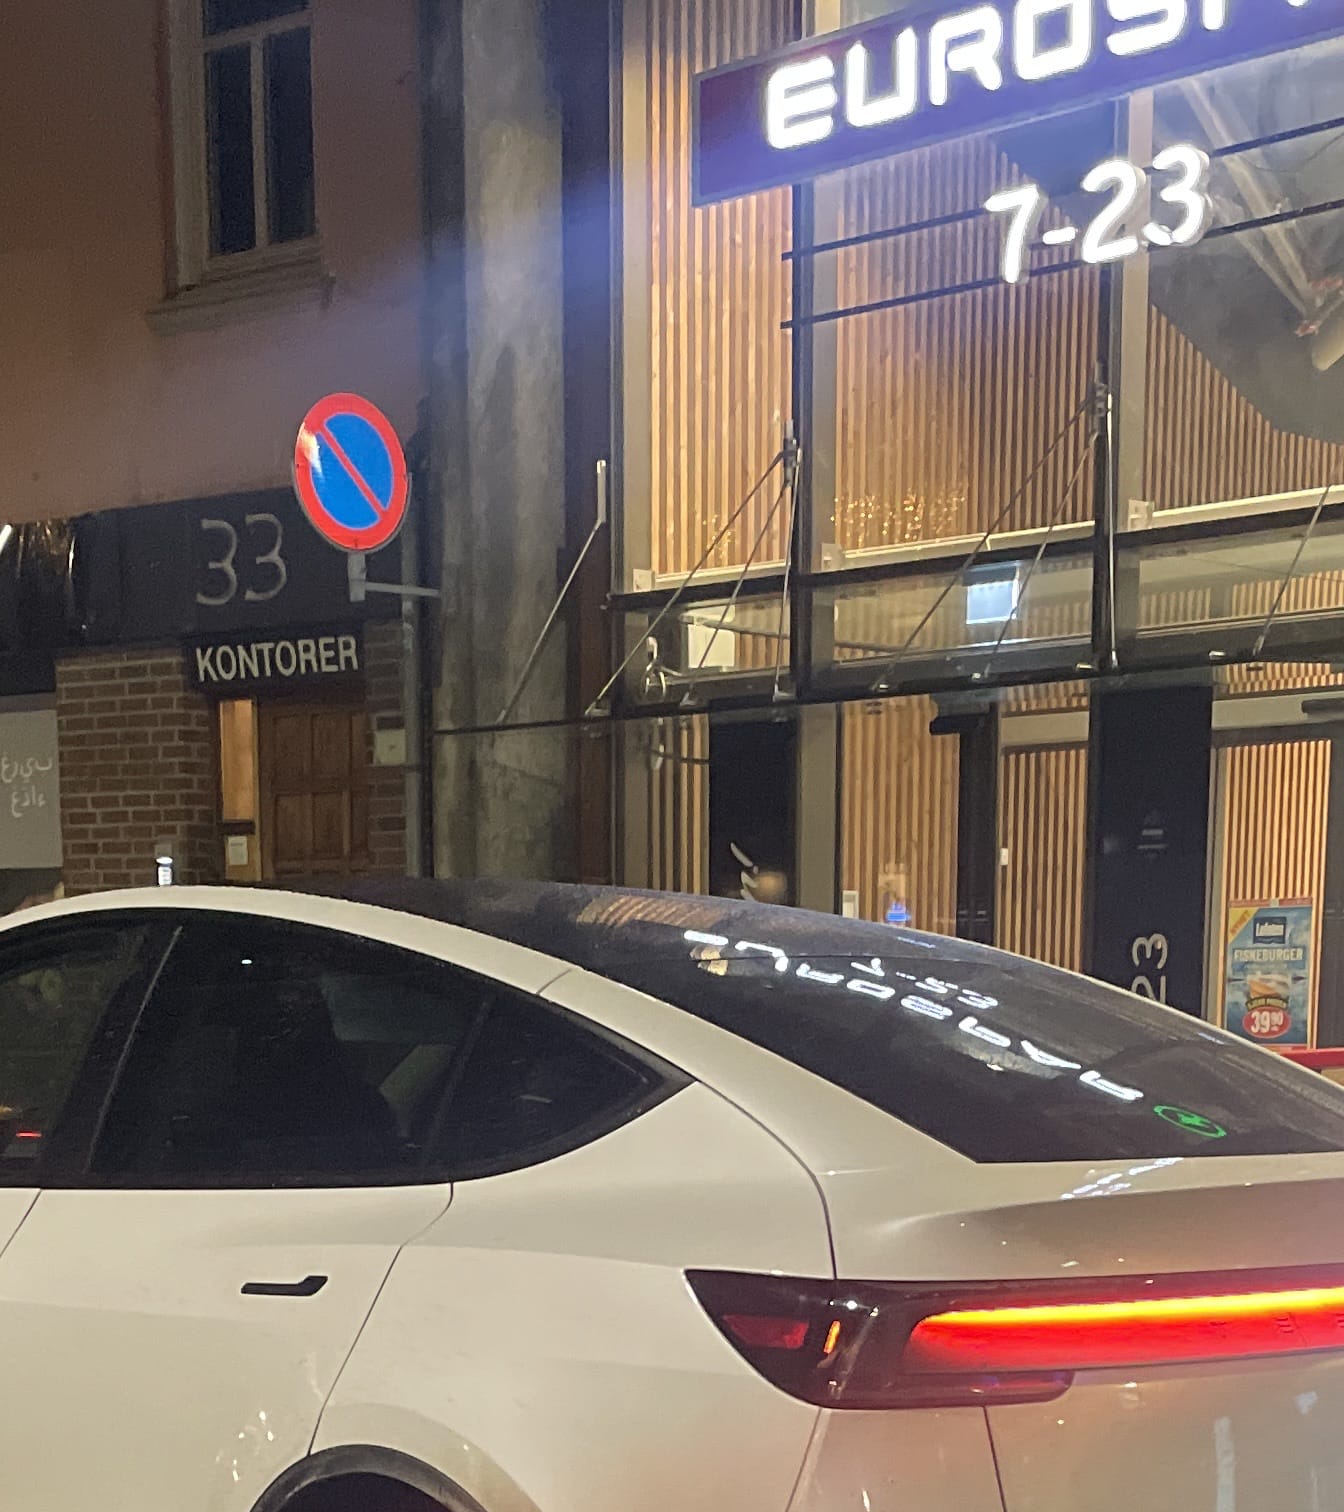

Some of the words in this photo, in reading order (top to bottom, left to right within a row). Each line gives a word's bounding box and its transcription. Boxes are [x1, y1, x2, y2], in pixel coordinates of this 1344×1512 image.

[765, 0, 1308, 151] EUROS
[984, 145, 1212, 284] 7-23
[196, 513, 287, 605] 33
[196, 635, 359, 682] KONTORER
[1233, 947, 1304, 961] FISKEBURGER
